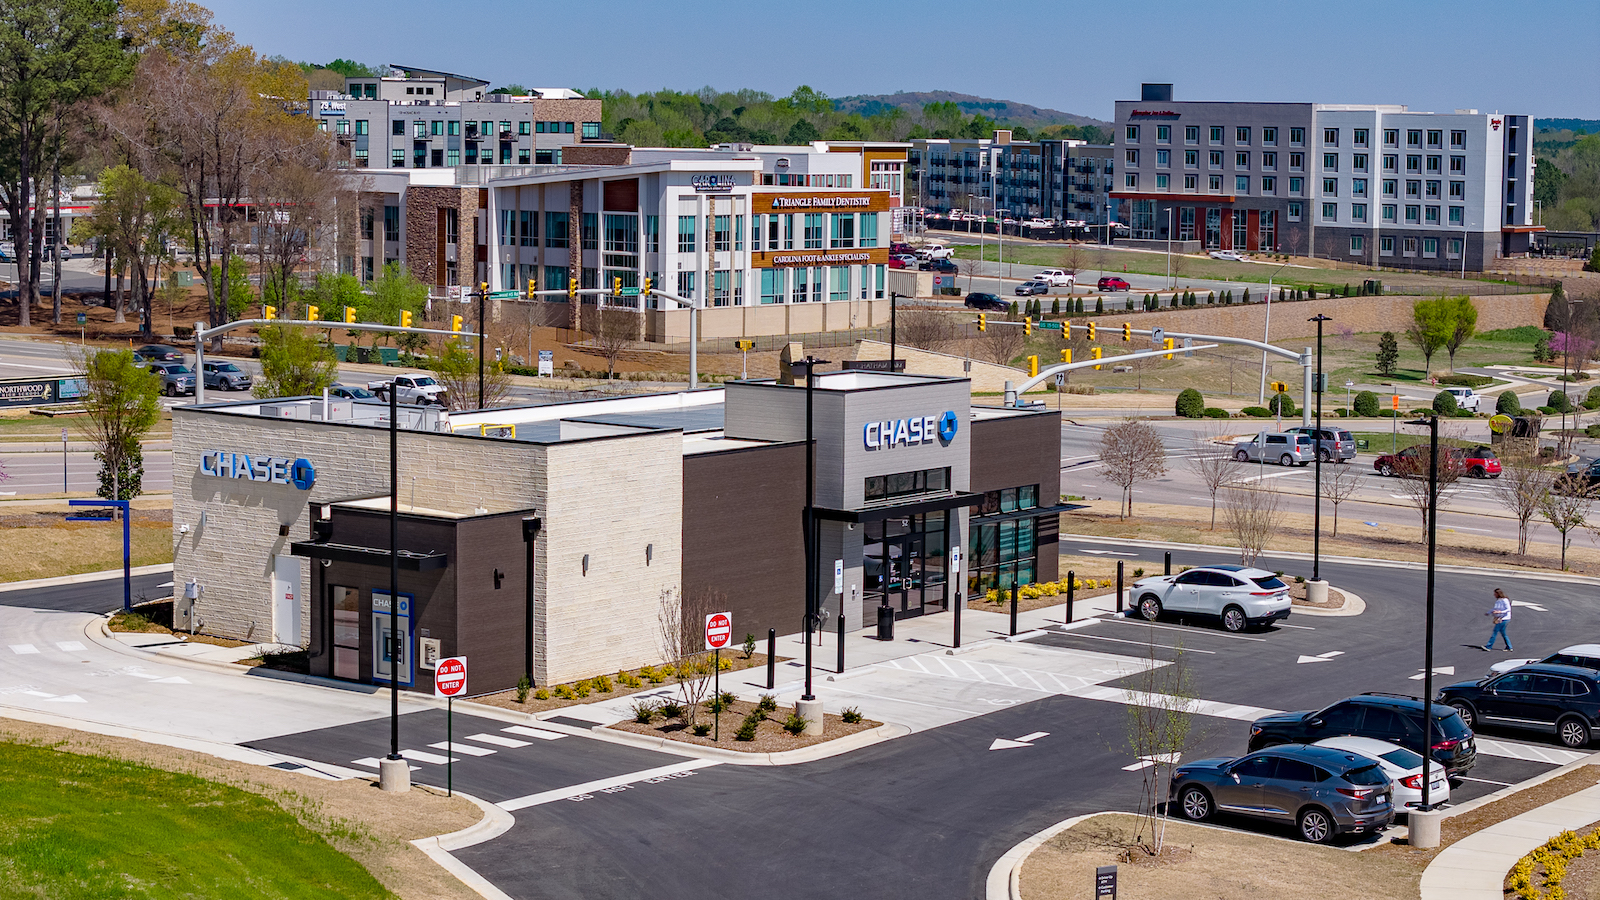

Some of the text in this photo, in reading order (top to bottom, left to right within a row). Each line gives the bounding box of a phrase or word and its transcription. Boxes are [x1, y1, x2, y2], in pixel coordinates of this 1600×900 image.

[692, 175, 736, 187] CAROLINA
[780, 197, 871, 207] TRIANGLE FAMILY DENTISTRY
[773, 255, 802, 263] CAROLINA
[802, 254, 817, 262] FOOT
[839, 252, 870, 261] SPECIALISTS
[0, 384, 43, 394] NORTHWOOD
[864, 415, 937, 447] CHASE
[200, 449, 289, 485] CHASE
[450, 664, 462, 672] NOT
[442, 681, 460, 690] ENTER
